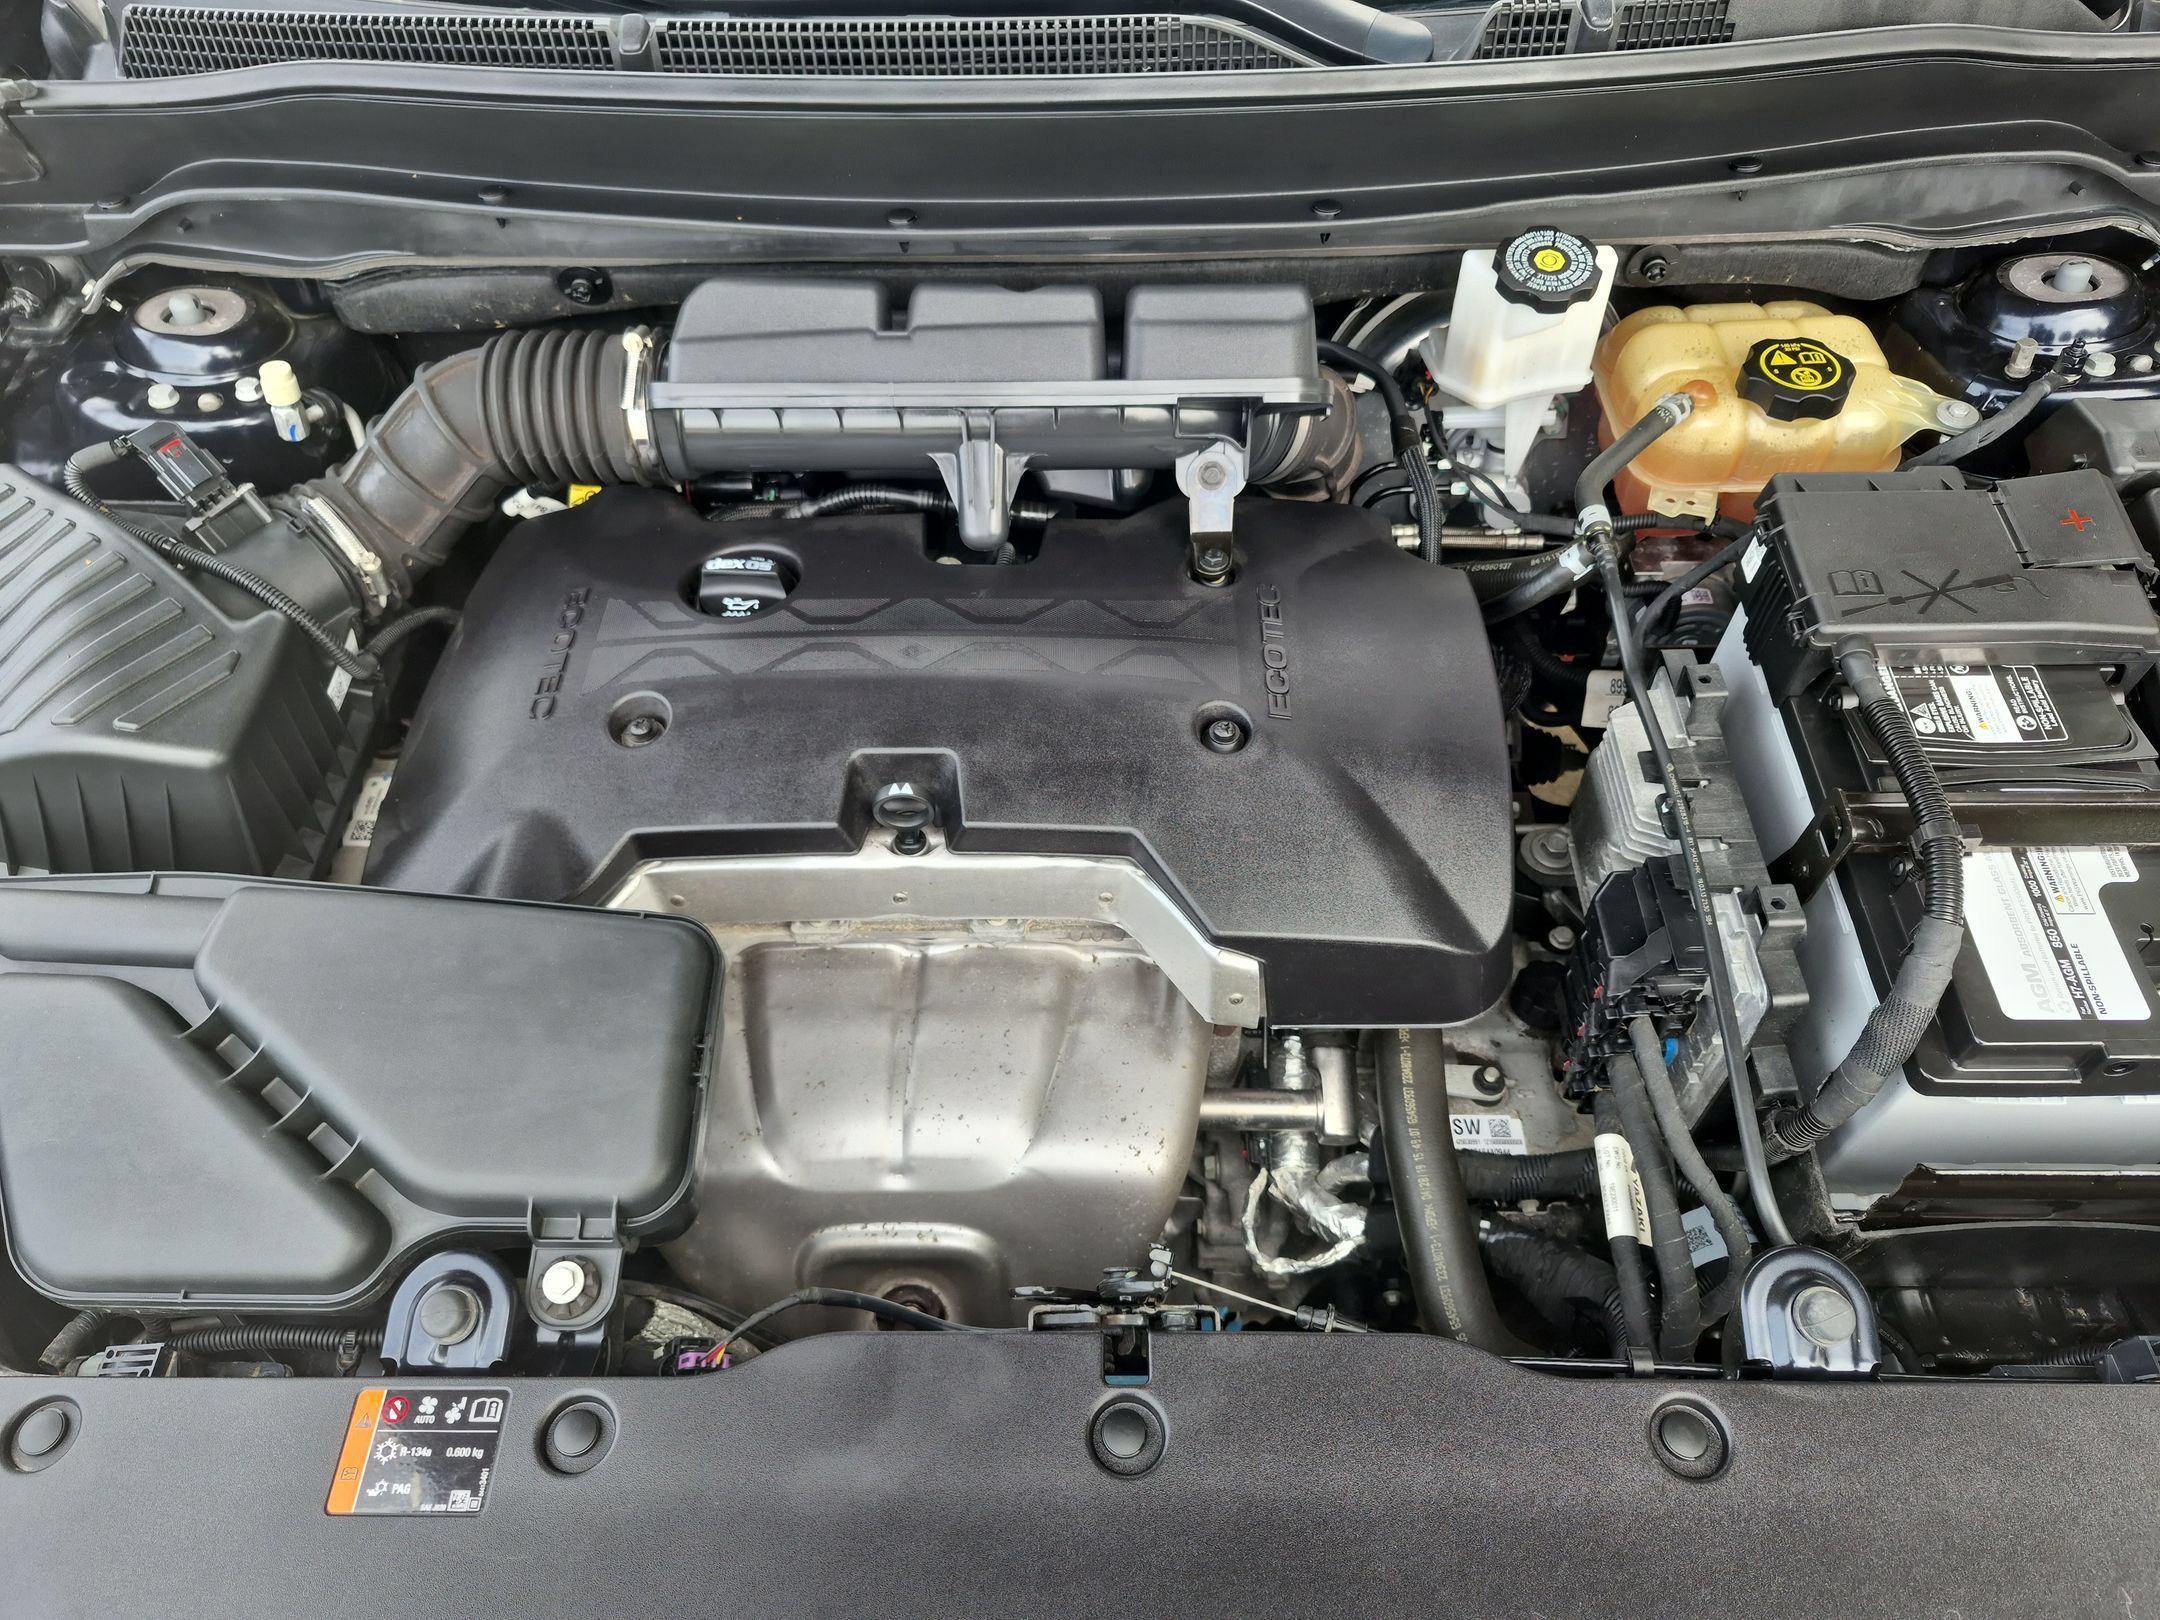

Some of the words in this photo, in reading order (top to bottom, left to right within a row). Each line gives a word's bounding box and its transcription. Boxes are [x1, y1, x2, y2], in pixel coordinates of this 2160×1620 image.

[529, 586, 592, 720] ECOTEC
[1256, 583, 1292, 719] ECOTEC
[1927, 679, 1939, 690] CAN
[2030, 679, 2046, 698] Battery
[1962, 688, 1986, 722] WARNING:
[2009, 698, 2022, 713] READ
[2018, 676, 2054, 729] NON-SPILLABLE
[2040, 700, 2051, 711] Acid
[1951, 717, 1964, 732] CAUSE
[2046, 714, 2058, 726] Lead
[1987, 864, 2006, 894] GLASS
[2027, 880, 2042, 897] 1000
[2001, 897, 2032, 956] ABSORBENT
[2046, 929, 2063, 947] 850
[2020, 963, 2054, 1012] AGM
[2058, 959, 2085, 998] H7-AGM
[2070, 943, 2107, 1014] NON-SPILLABLE
[1453, 1118, 1480, 1135] SW
[1632, 1178, 1646, 1232] YAZAKI
[414, 1415, 436, 1424] AUTO
[399, 1446, 433, 1457] R-134a
[446, 1446, 471, 1458] 0.600
[473, 1446, 484, 1460] kg
[391, 1483, 411, 1495] PAG
